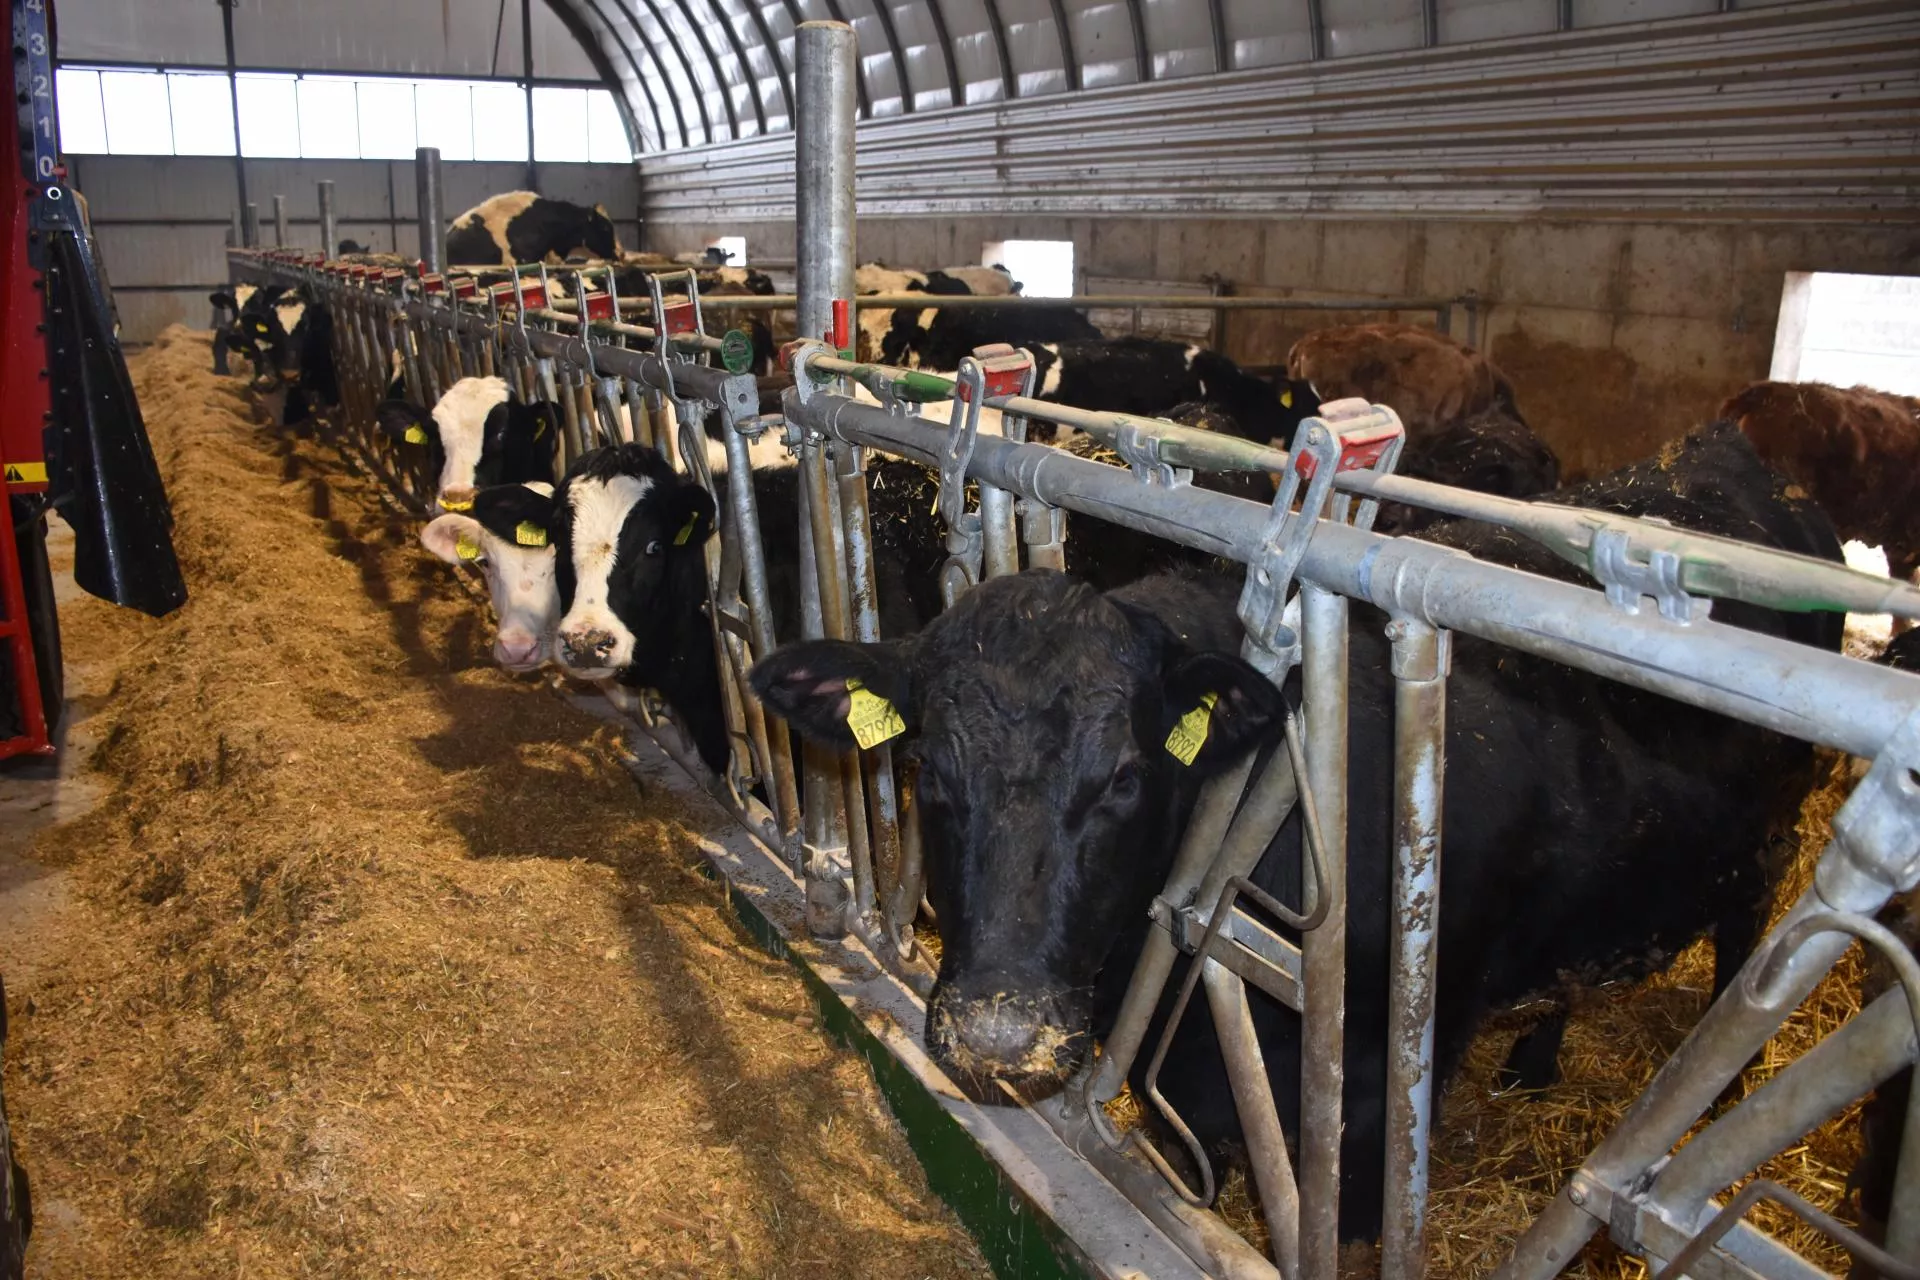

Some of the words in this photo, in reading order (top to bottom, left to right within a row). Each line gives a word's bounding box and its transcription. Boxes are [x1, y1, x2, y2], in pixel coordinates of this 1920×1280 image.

[31, 33, 46, 56] 3
[33, 76, 49, 97] 2
[38, 117, 50, 138] 1
[39, 156, 54, 177] 0
[857, 715, 899, 746] 8792
[1168, 730, 1196, 763] 8792
